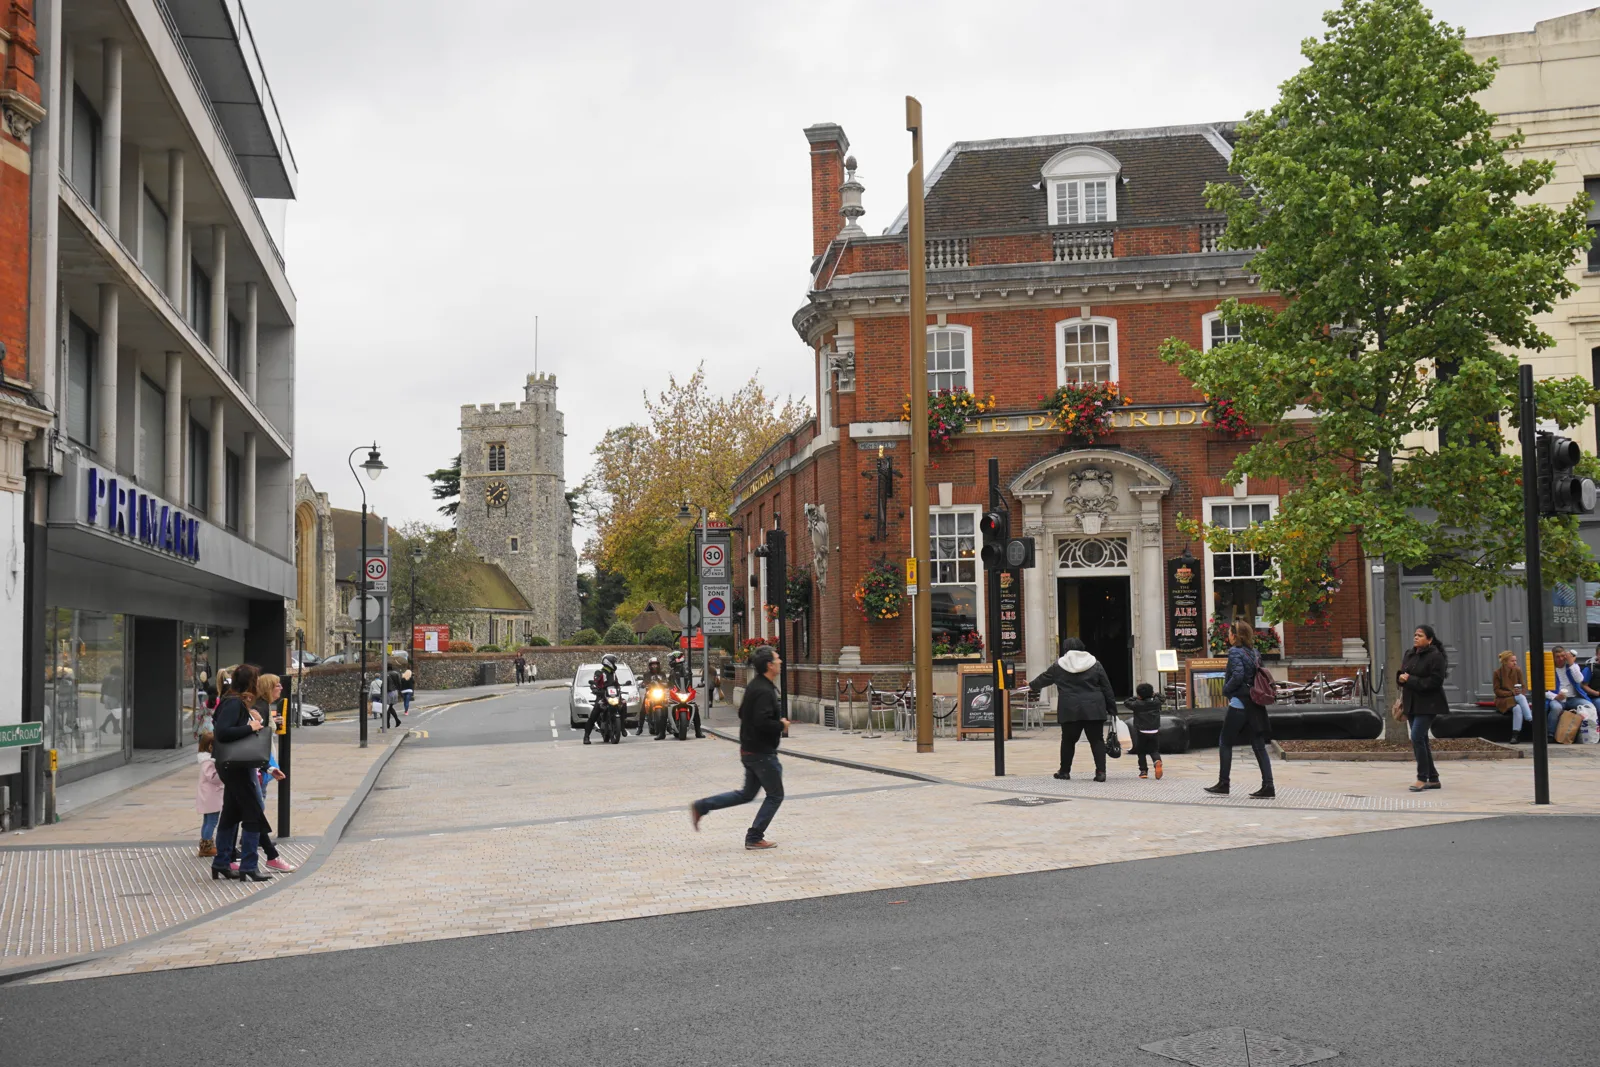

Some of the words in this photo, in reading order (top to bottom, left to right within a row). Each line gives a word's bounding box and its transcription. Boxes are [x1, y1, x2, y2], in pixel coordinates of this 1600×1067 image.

[962, 417, 1010, 433] HE
[1027, 406, 1213, 430] PTRID
[87, 467, 200, 564] PRIMARK
[706, 551, 721, 560] 30
[368, 564, 383, 574] 30
[1001, 611, 1017, 621] LES
[1174, 607, 1197, 617] ALES
[1001, 631, 1016, 639] IES
[1175, 628, 1197, 636] PIES
[20, 728, 39, 740] ROAD
